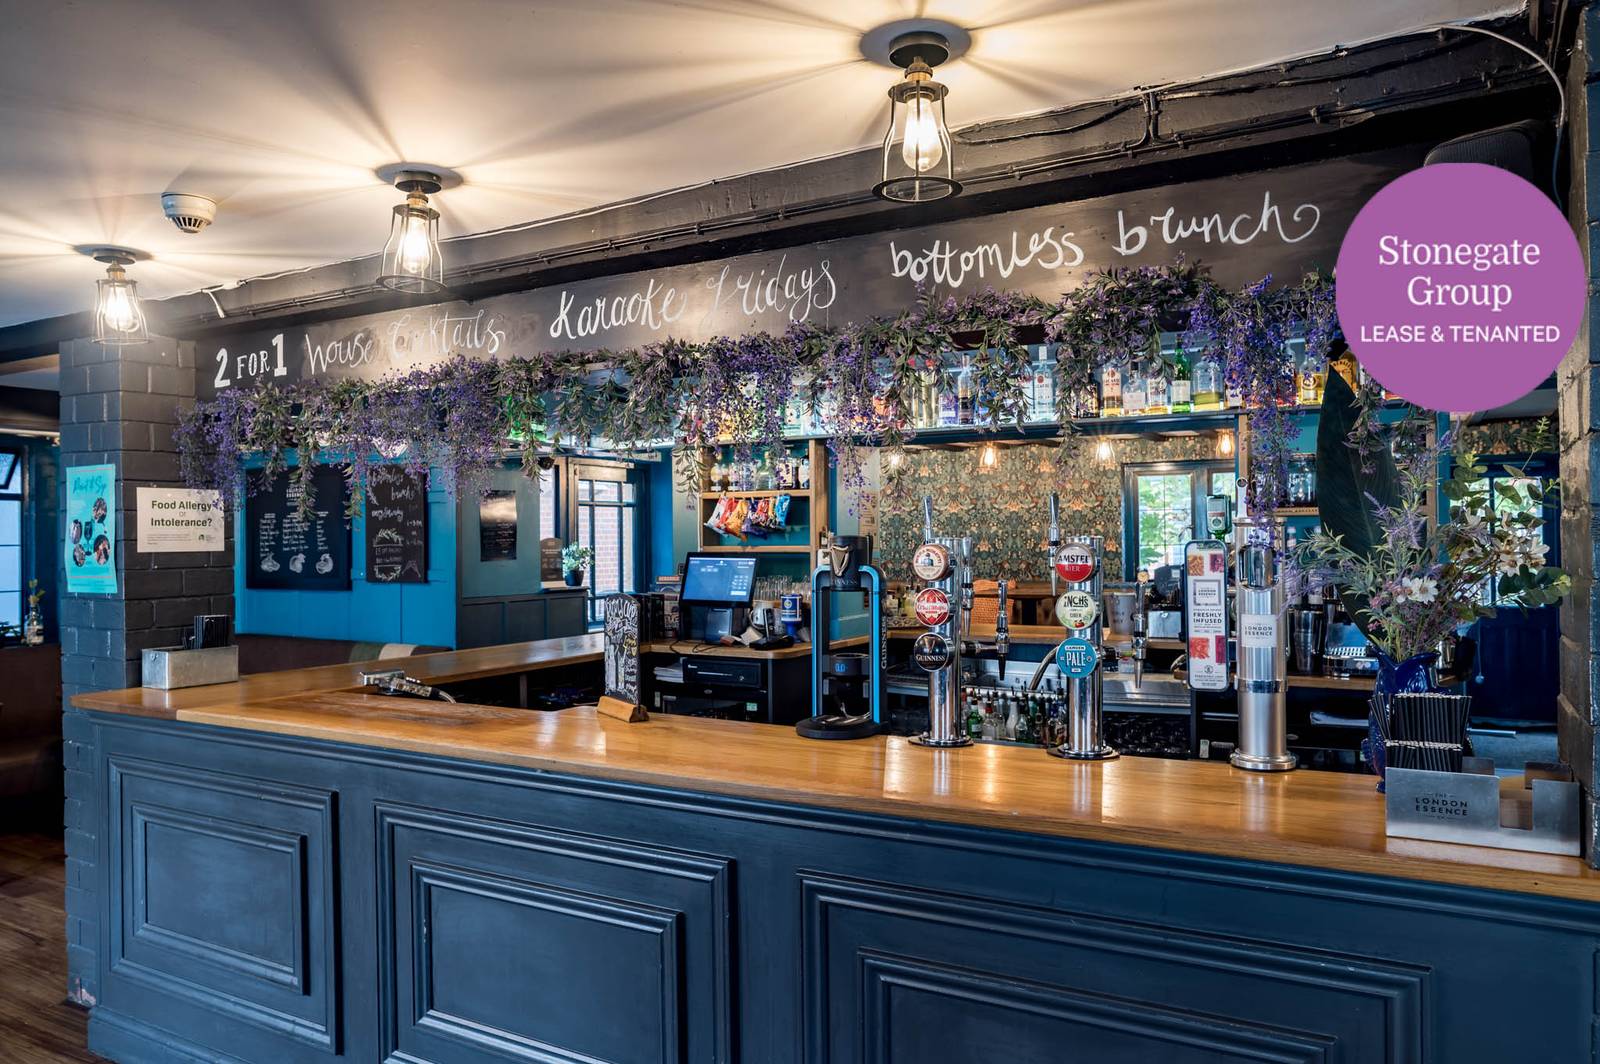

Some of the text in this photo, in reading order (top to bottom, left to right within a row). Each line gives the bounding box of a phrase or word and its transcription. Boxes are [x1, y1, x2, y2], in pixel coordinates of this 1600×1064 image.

[889, 191, 1320, 288] bottomless brunch
[549, 279, 687, 340] Karaoke
[214, 347, 231, 389] 2
[236, 349, 270, 380] FOR
[271, 333, 288, 377] 1
[386, 308, 506, 358] Cktails
[151, 500, 212, 512] Food Allergy
[151, 517, 213, 527] Intolerance?
[1057, 554, 1089, 563] AMSTEL
[1066, 651, 1086, 666] PALE
[1415, 797, 1468, 808] LONDON
[1415, 804, 1469, 816] ESSENCE
